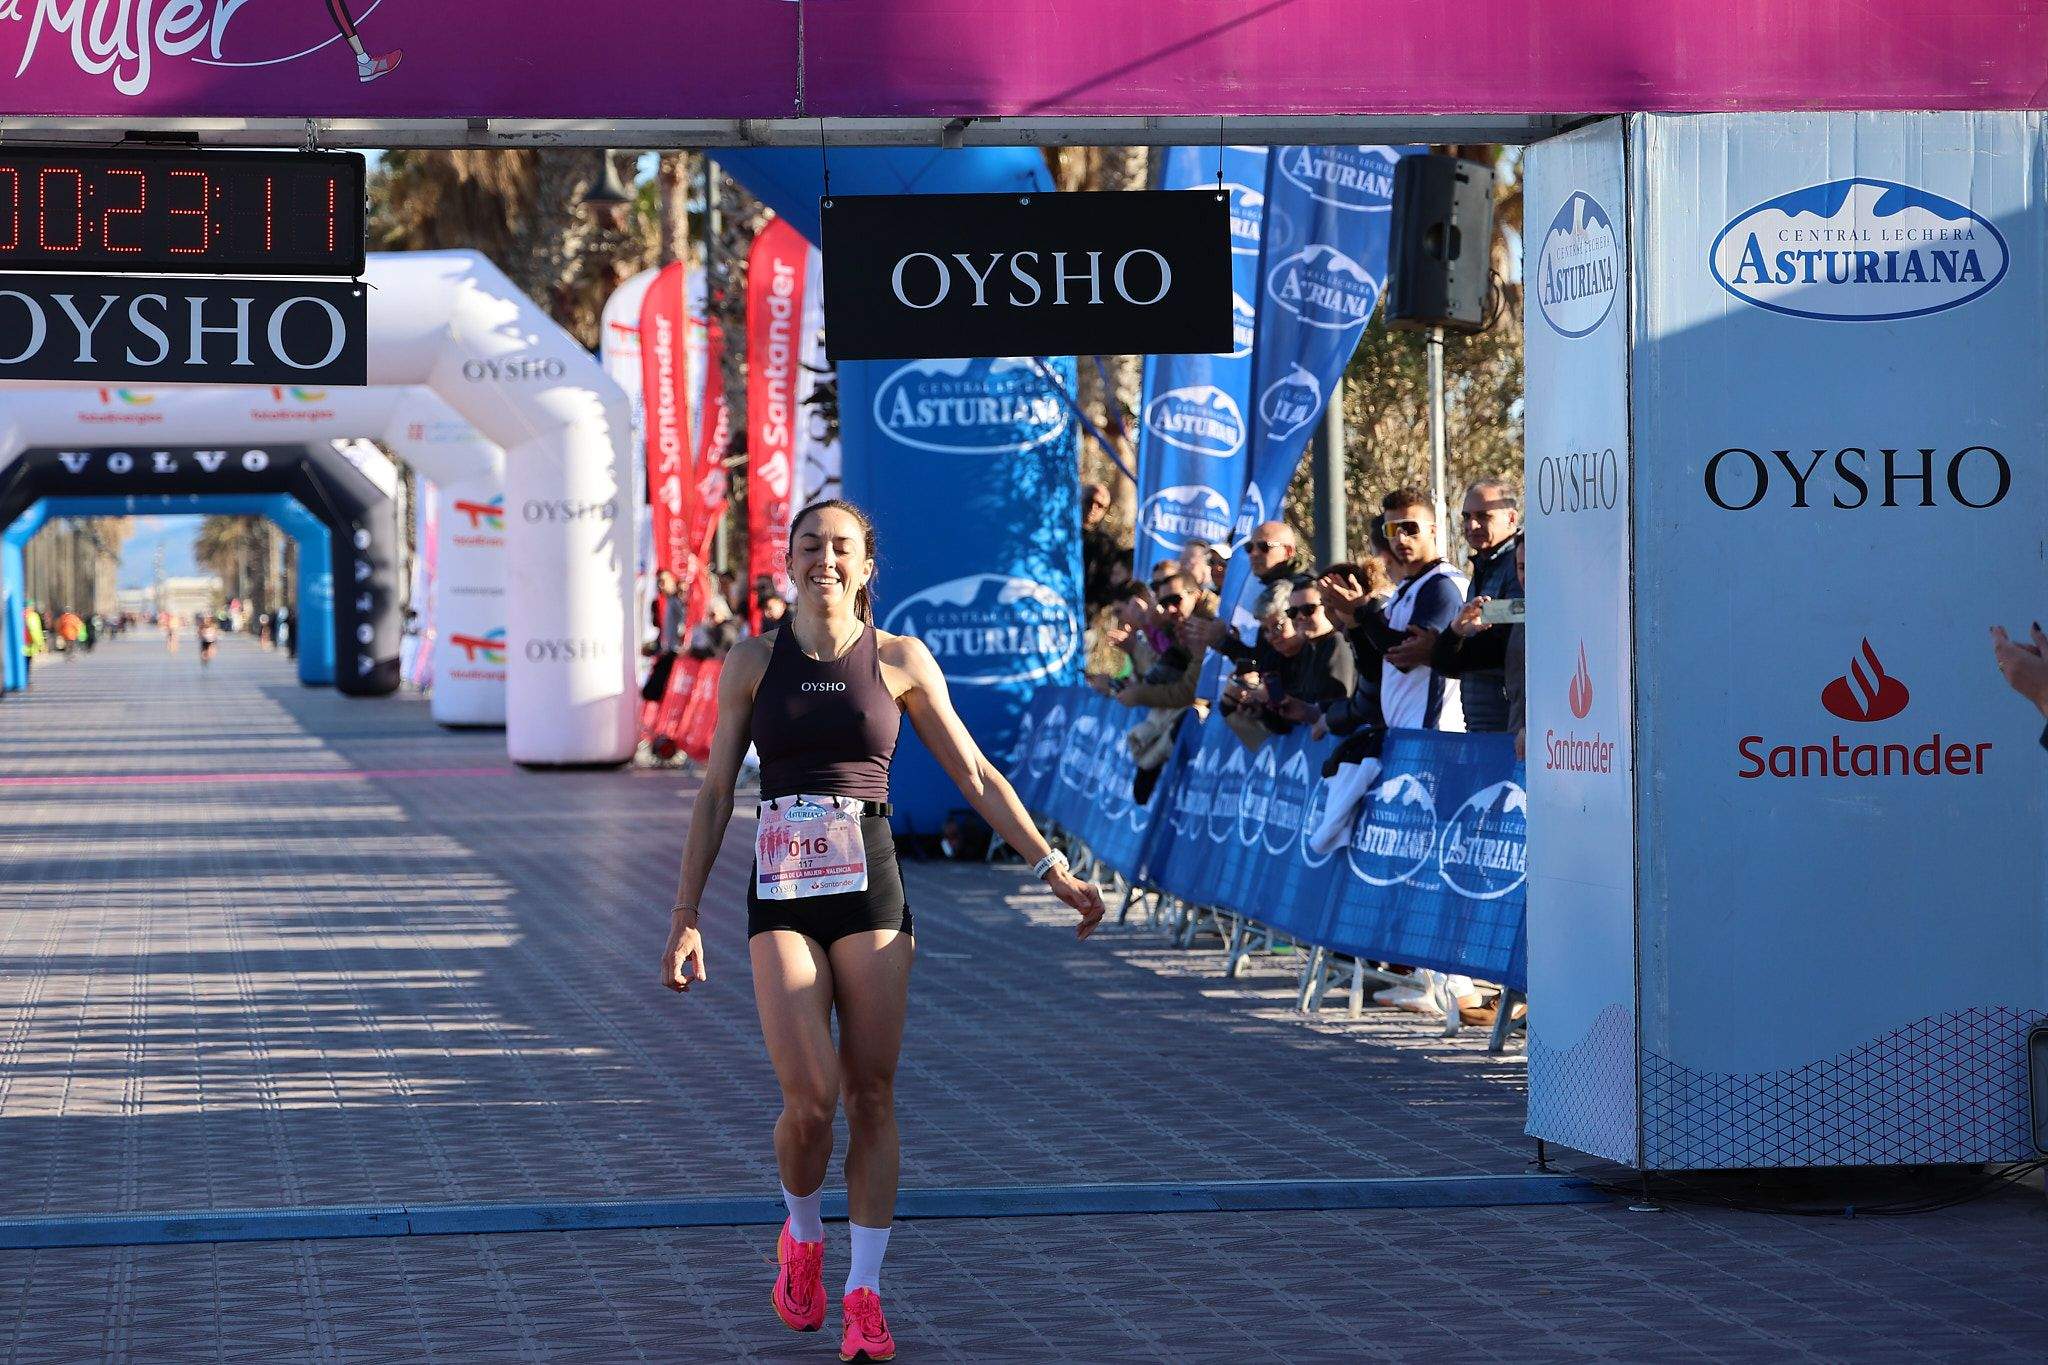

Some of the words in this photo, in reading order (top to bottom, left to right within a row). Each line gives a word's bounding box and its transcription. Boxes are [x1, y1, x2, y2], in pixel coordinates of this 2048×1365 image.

[1732, 232, 1986, 285] ASTURIANA
[1778, 229, 1871, 242] CENTRAL
[1881, 228, 1976, 241] LECHERA
[891, 248, 1172, 309] OYSHO
[1544, 253, 1614, 305] ASTURIANA
[0, 290, 346, 369] OYSHO
[762, 257, 795, 447] Santander
[463, 358, 566, 382] OYSHO
[655, 313, 681, 473] Santander
[58, 449, 269, 474] VOLVO
[1538, 448, 1618, 517] OYSHO
[1703, 445, 2012, 511] OYSHO
[801, 682, 846, 692] OYSHO
[1546, 729, 1614, 774] Santander
[1738, 733, 1994, 778] Santander
[788, 837, 828, 857] 016
[820, 879, 854, 888] Santander
